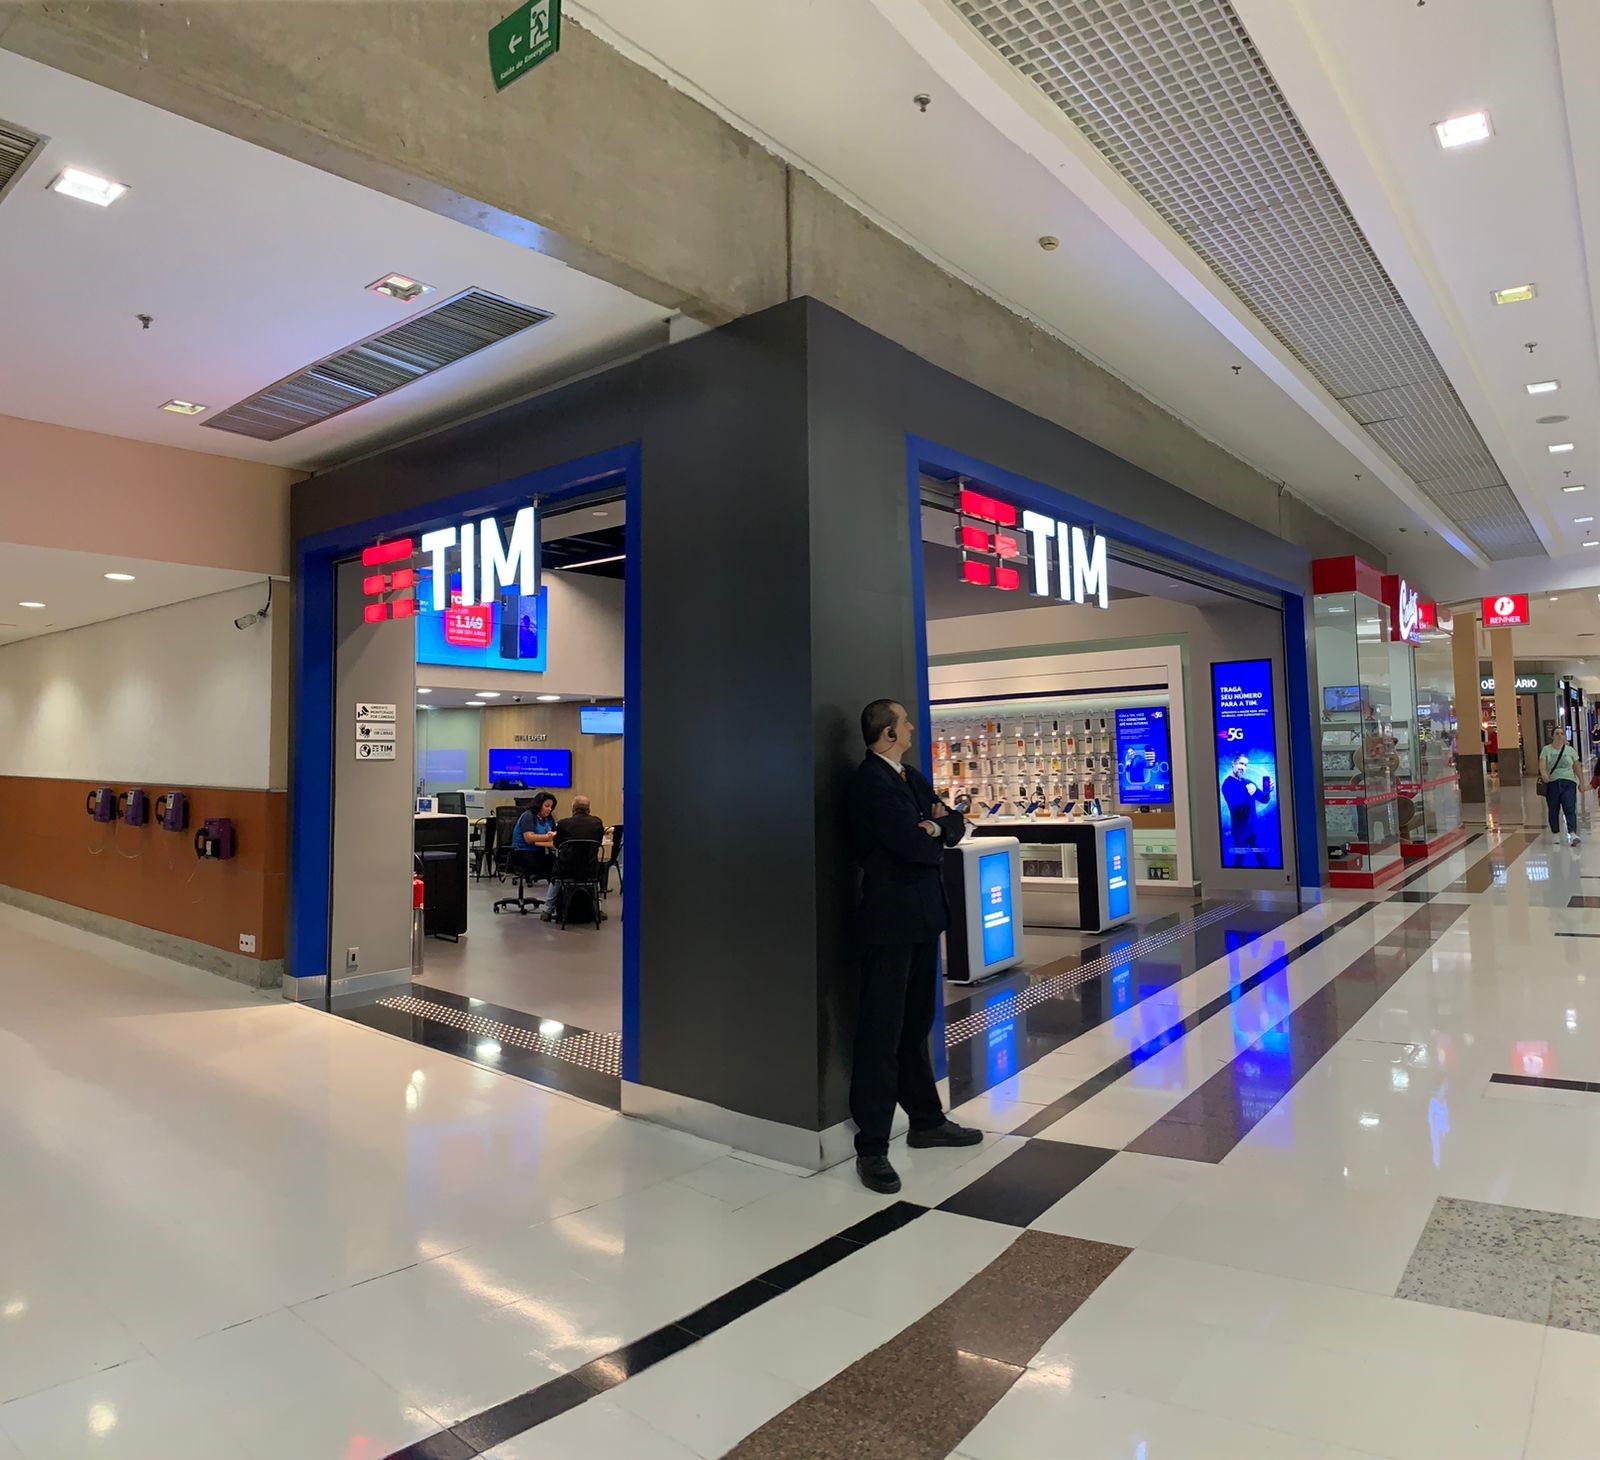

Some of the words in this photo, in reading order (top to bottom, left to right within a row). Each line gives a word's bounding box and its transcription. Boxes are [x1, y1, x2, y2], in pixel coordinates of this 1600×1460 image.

[421, 507, 536, 611] TIM
[1022, 510, 1109, 609] TIM
[1490, 616, 1520, 624] RENNER
[1234, 692, 1262, 700] NÚMERO
[1226, 727, 1244, 742] 5G
[380, 744, 393, 752] TIM
